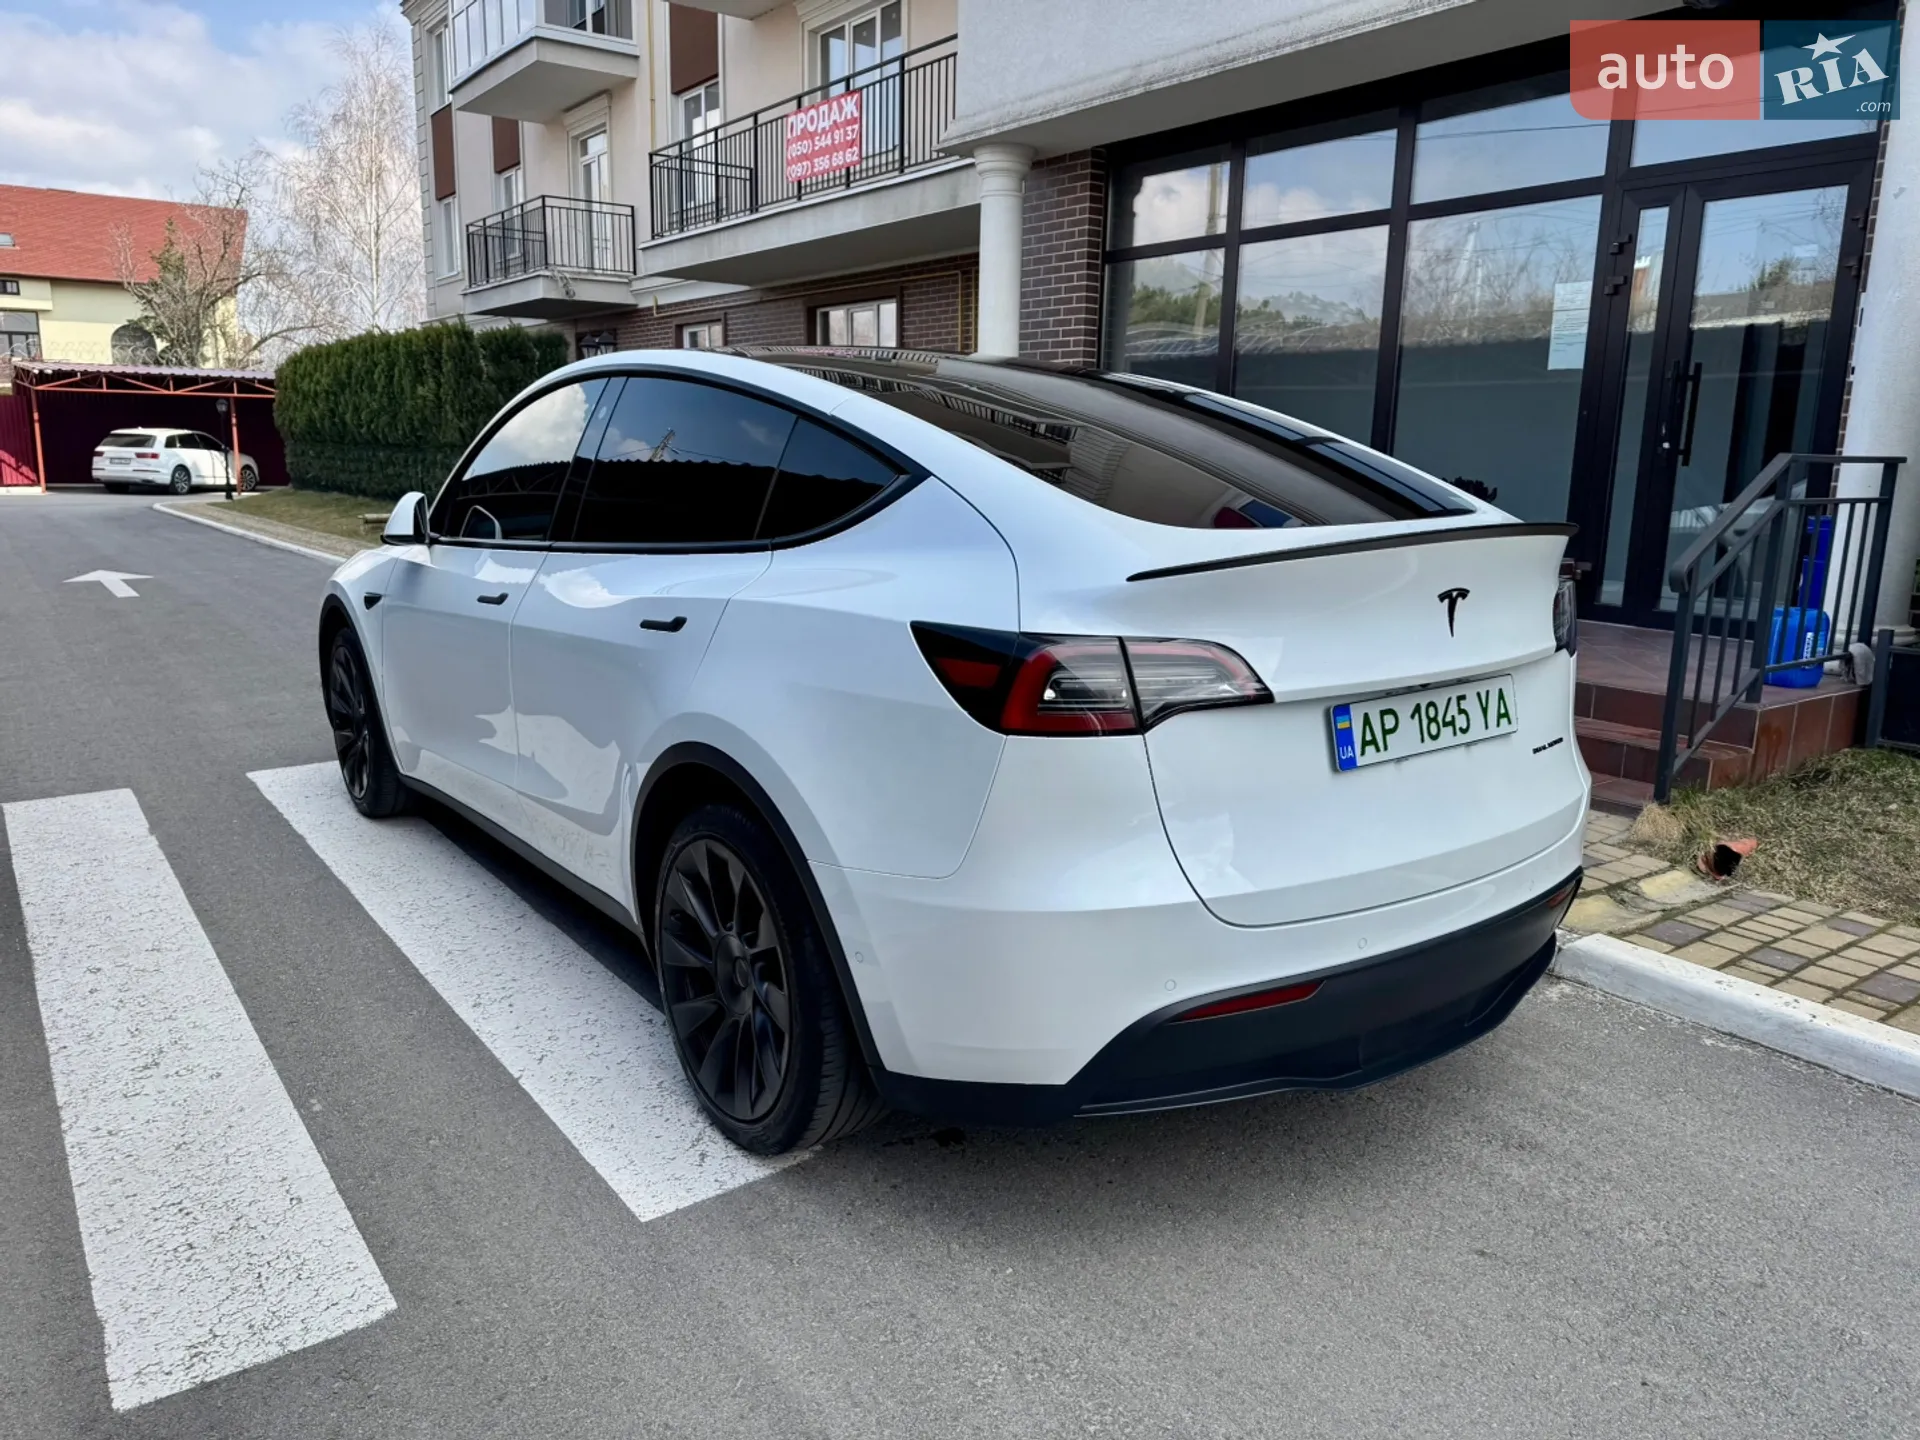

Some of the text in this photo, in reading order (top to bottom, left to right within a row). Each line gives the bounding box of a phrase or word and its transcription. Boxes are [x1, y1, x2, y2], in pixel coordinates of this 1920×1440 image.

[787, 93, 859, 139] ПРОДАЖ
[814, 132, 832, 150] 544
[834, 128, 844, 144] 91
[846, 124, 859, 140] 37
[787, 160, 811, 179] (097)
[813, 154, 830, 172] 356
[845, 146, 859, 162] 62
[1360, 688, 1512, 757] AP 1845 YA
[1339, 746, 1354, 760] UA
